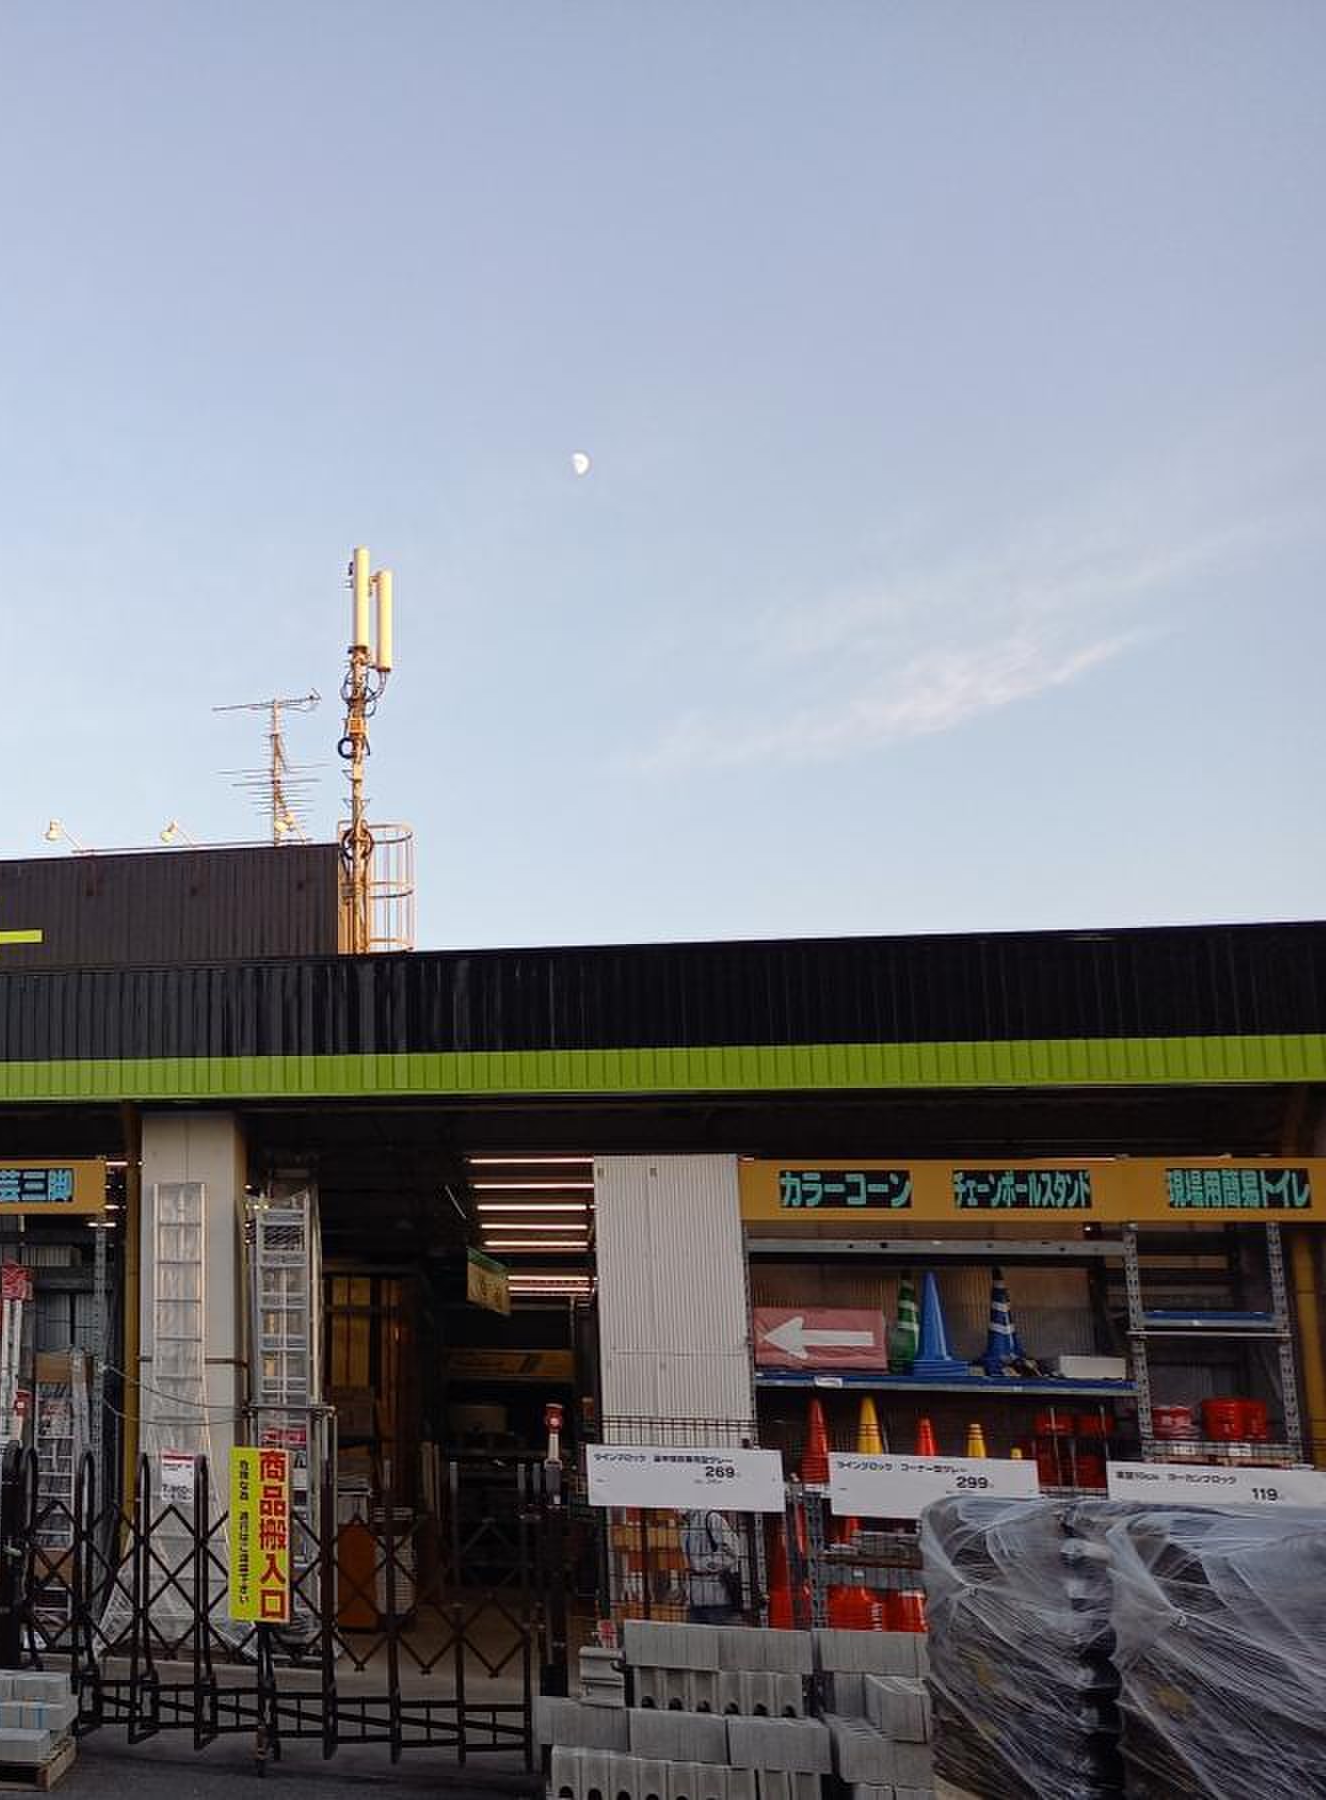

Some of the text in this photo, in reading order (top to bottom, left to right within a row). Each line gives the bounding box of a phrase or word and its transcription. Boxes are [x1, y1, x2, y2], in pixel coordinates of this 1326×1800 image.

[780, 1171, 912, 1206] カラーコーン
[1166, 1169, 1310, 1207] 現場用簡易トイレ
[705, 1466, 736, 1479] 269
[956, 1476, 989, 1489] 299
[1252, 1487, 1279, 1501] 119
[260, 1451, 288, 1618] 商品搬入口
